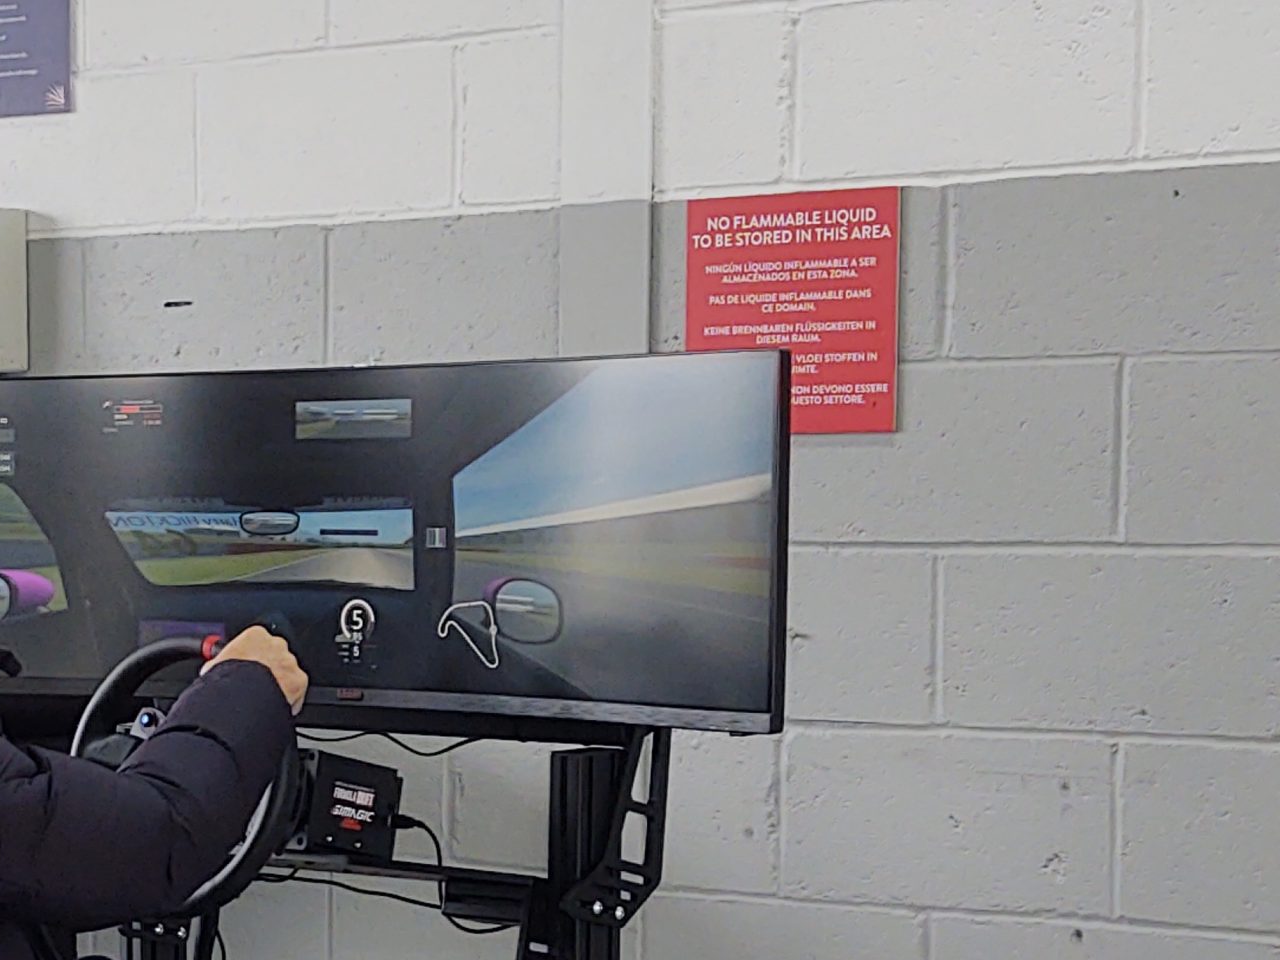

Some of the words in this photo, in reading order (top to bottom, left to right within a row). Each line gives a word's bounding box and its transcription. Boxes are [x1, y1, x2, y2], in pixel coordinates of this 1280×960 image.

[707, 217, 730, 231] NO
[733, 210, 821, 229] FLAMMABLE
[825, 207, 877, 226] LIQUID
[692, 235, 712, 249] TO
[715, 233, 732, 247] BE
[736, 230, 793, 246] STORED
[796, 229, 812, 243] IN
[814, 226, 848, 242] THIS
[850, 224, 892, 240] AREA
[784, 258, 849, 271] INFLAMMABLE
[850, 258, 857, 267] A
[858, 257, 877, 267] SER
[792, 271, 805, 280] EN
[806, 270, 828, 280] ESTA
[709, 295, 727, 305] PAS
[728, 295, 740, 304] DE
[741, 293, 777, 305] LIQUIDE
[778, 290, 844, 302] INFLAMMABLE
[845, 288, 872, 299] DANS
[761, 304, 774, 313] CE
[704, 326, 731, 336] KEINE
[732, 323, 794, 335] BRENNBAREN
[865, 320, 876, 330] IN
[756, 335, 790, 344] DIESEM
[867, 352, 878, 361] IN
[812, 384, 853, 394] DEVONO
[855, 382, 889, 393] ESSERE
[791, 395, 823, 405] UESTO
[351, 609, 364, 631] 5
